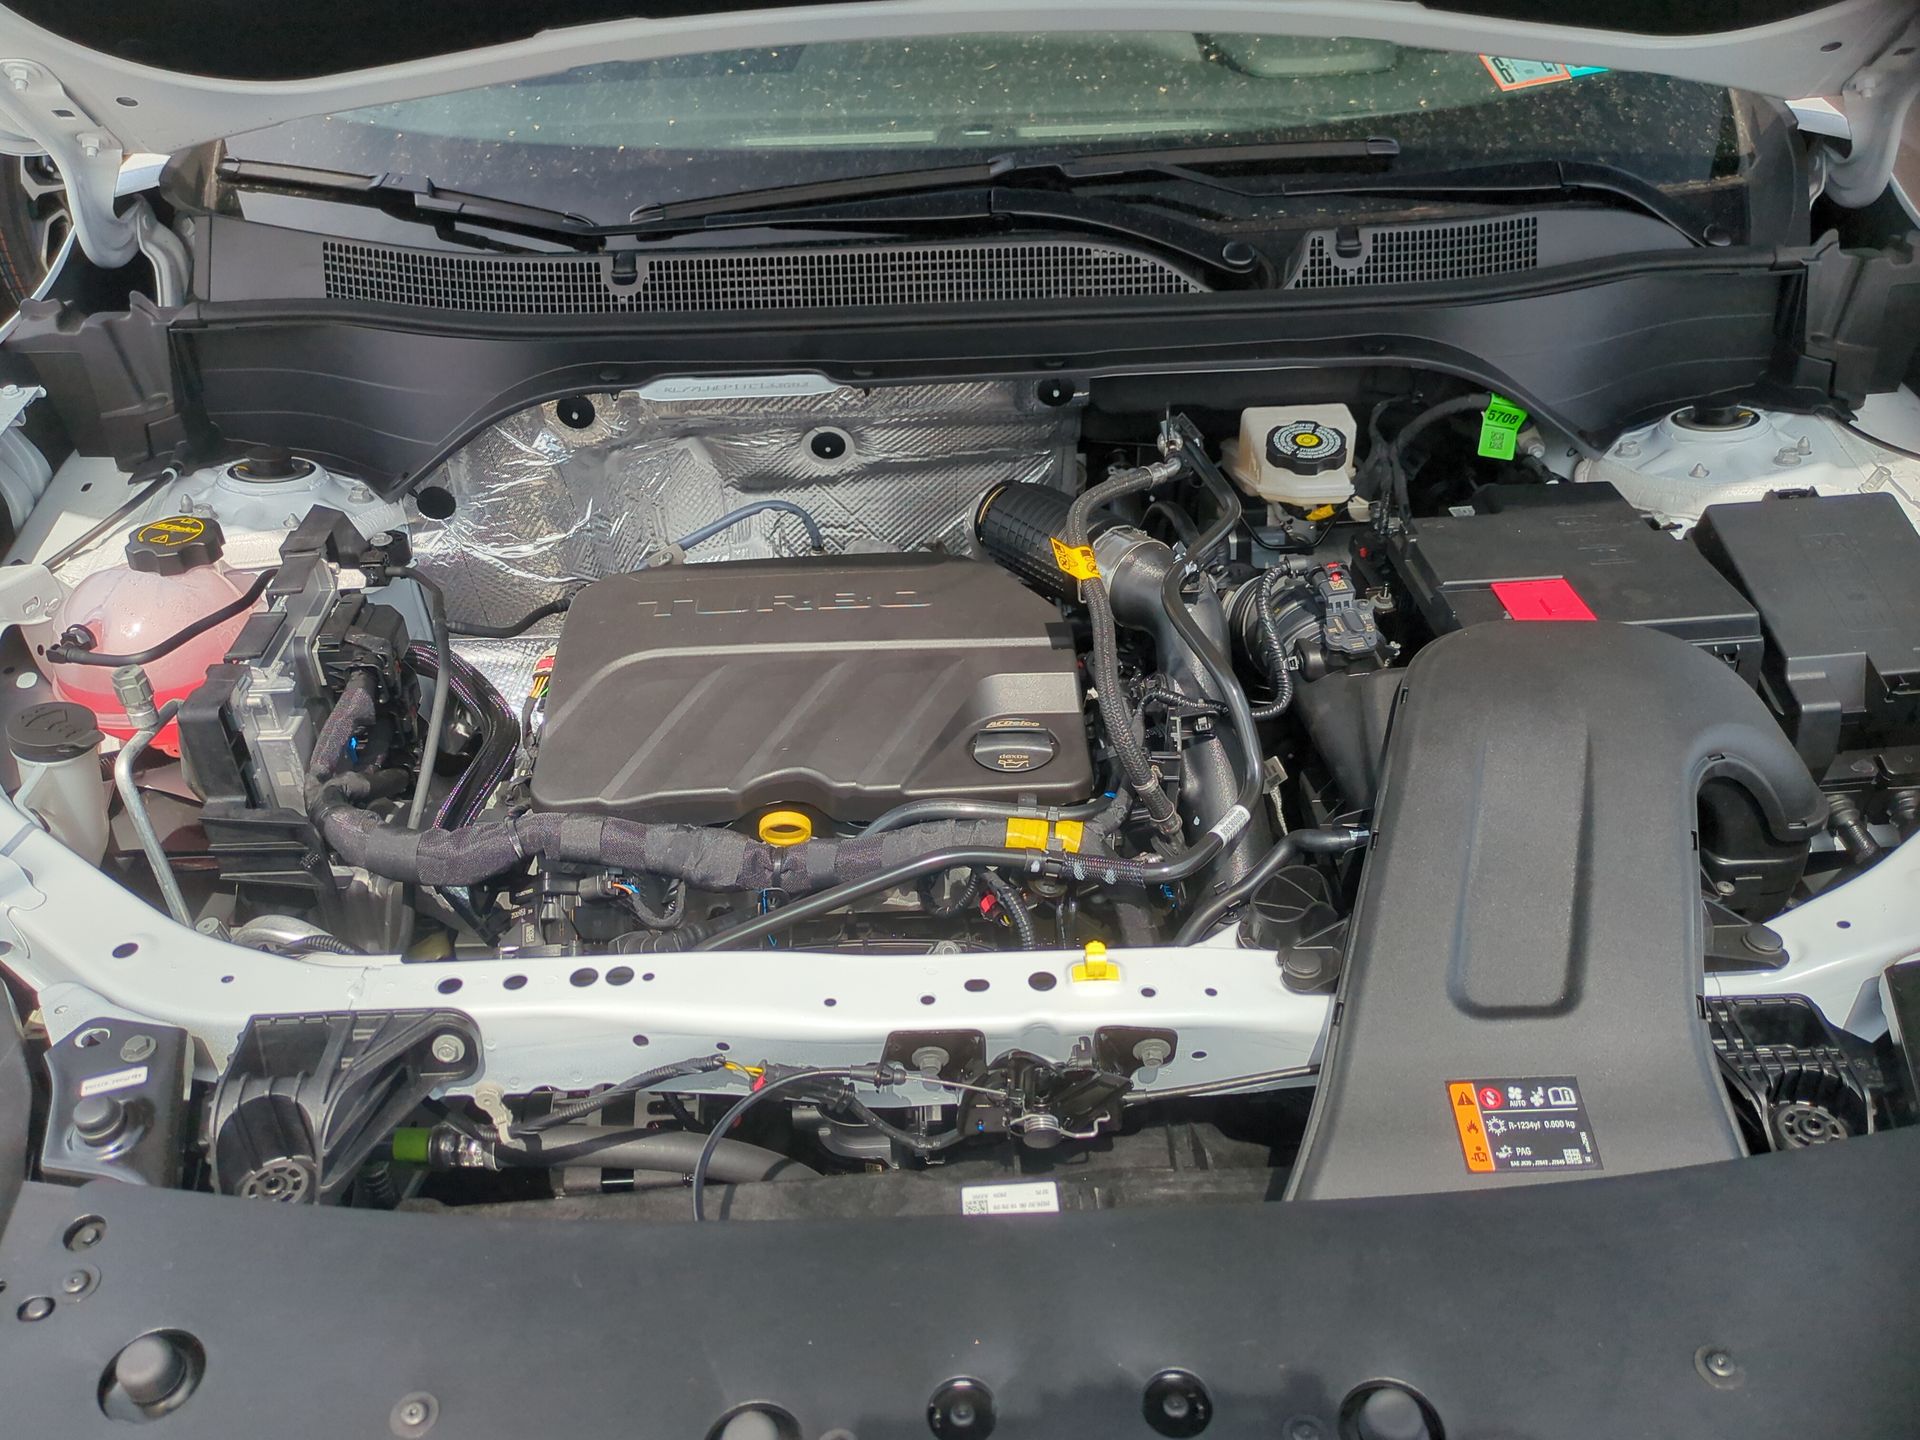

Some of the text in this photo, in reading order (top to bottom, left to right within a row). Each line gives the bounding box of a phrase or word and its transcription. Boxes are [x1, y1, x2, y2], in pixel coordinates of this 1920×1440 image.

[1487, 410, 1519, 425] 5708
[637, 590, 932, 617] TURBO
[986, 720, 1040, 729] ACDelco
[1508, 1121, 1540, 1131] R-1234yf
[1565, 1120, 1576, 1130] kg
[1516, 1147, 1532, 1156] PAG
